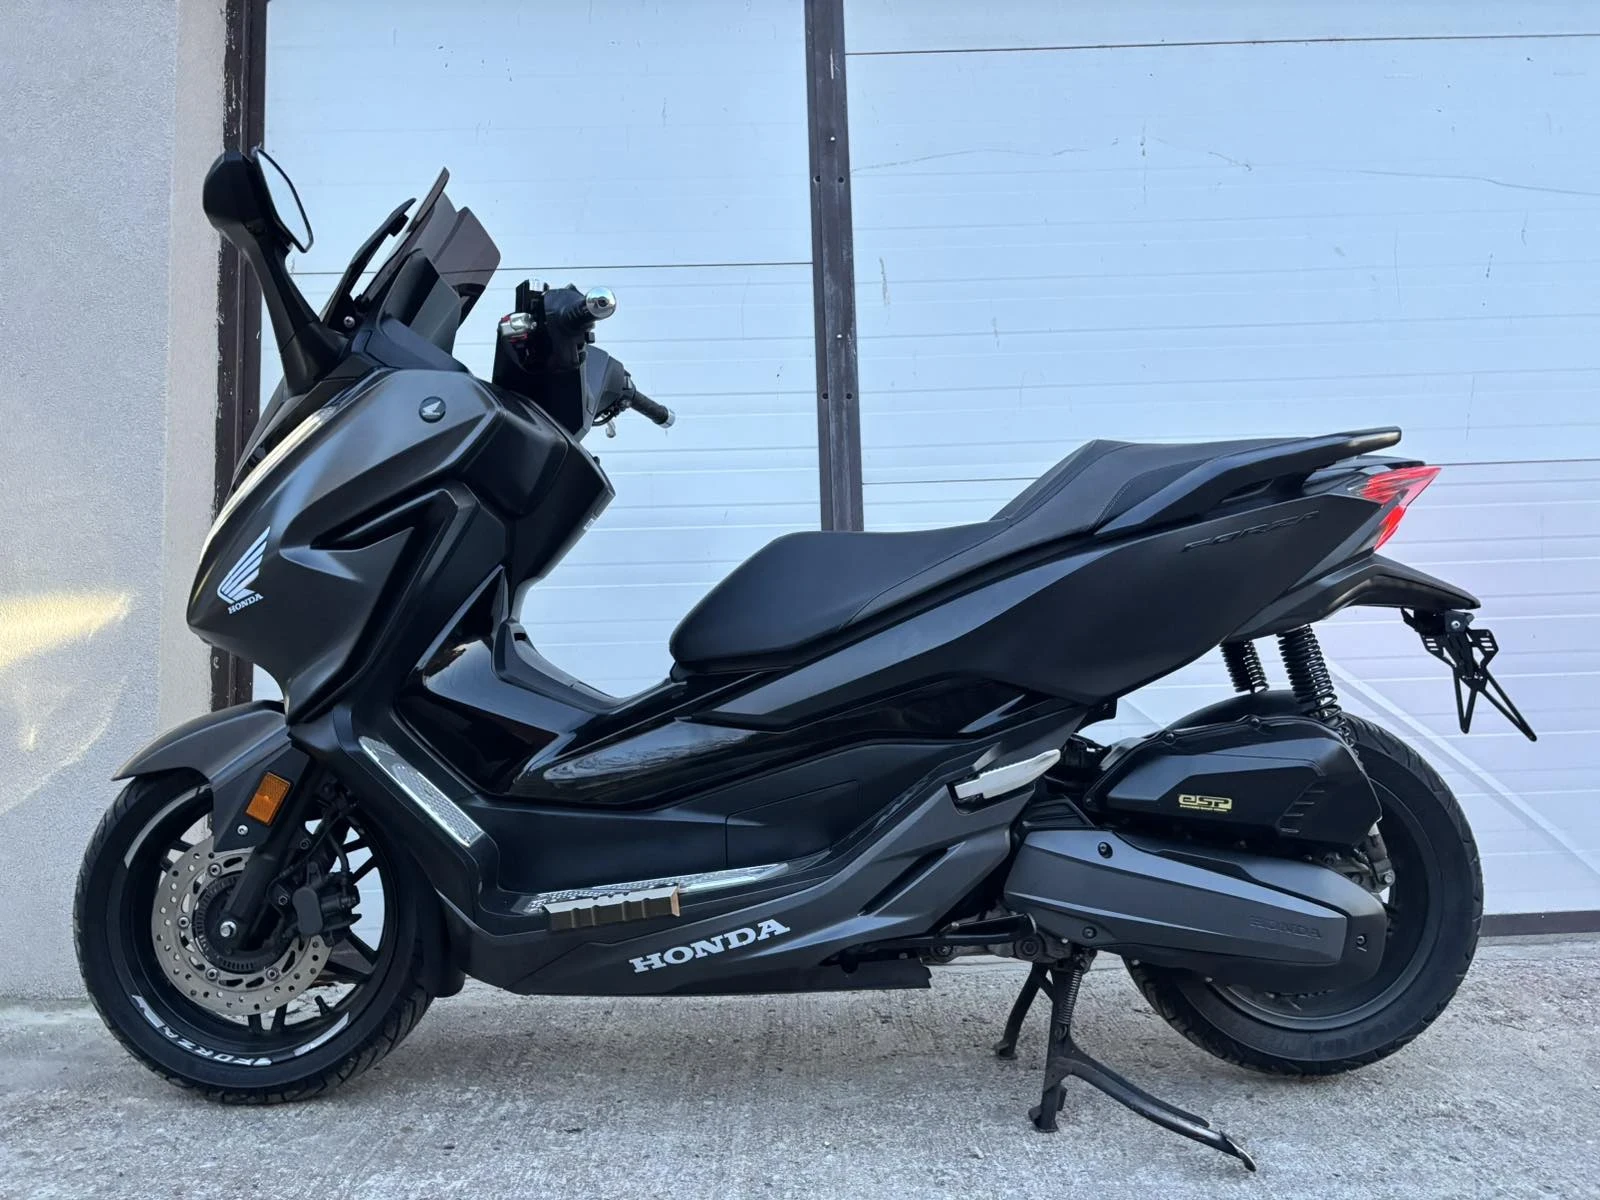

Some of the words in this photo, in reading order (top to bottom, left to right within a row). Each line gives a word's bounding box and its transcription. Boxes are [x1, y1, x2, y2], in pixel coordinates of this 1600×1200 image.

[228, 593, 264, 614] HONDA
[629, 919, 791, 973] HONDA
[163, 1026, 255, 1066] FORZA
